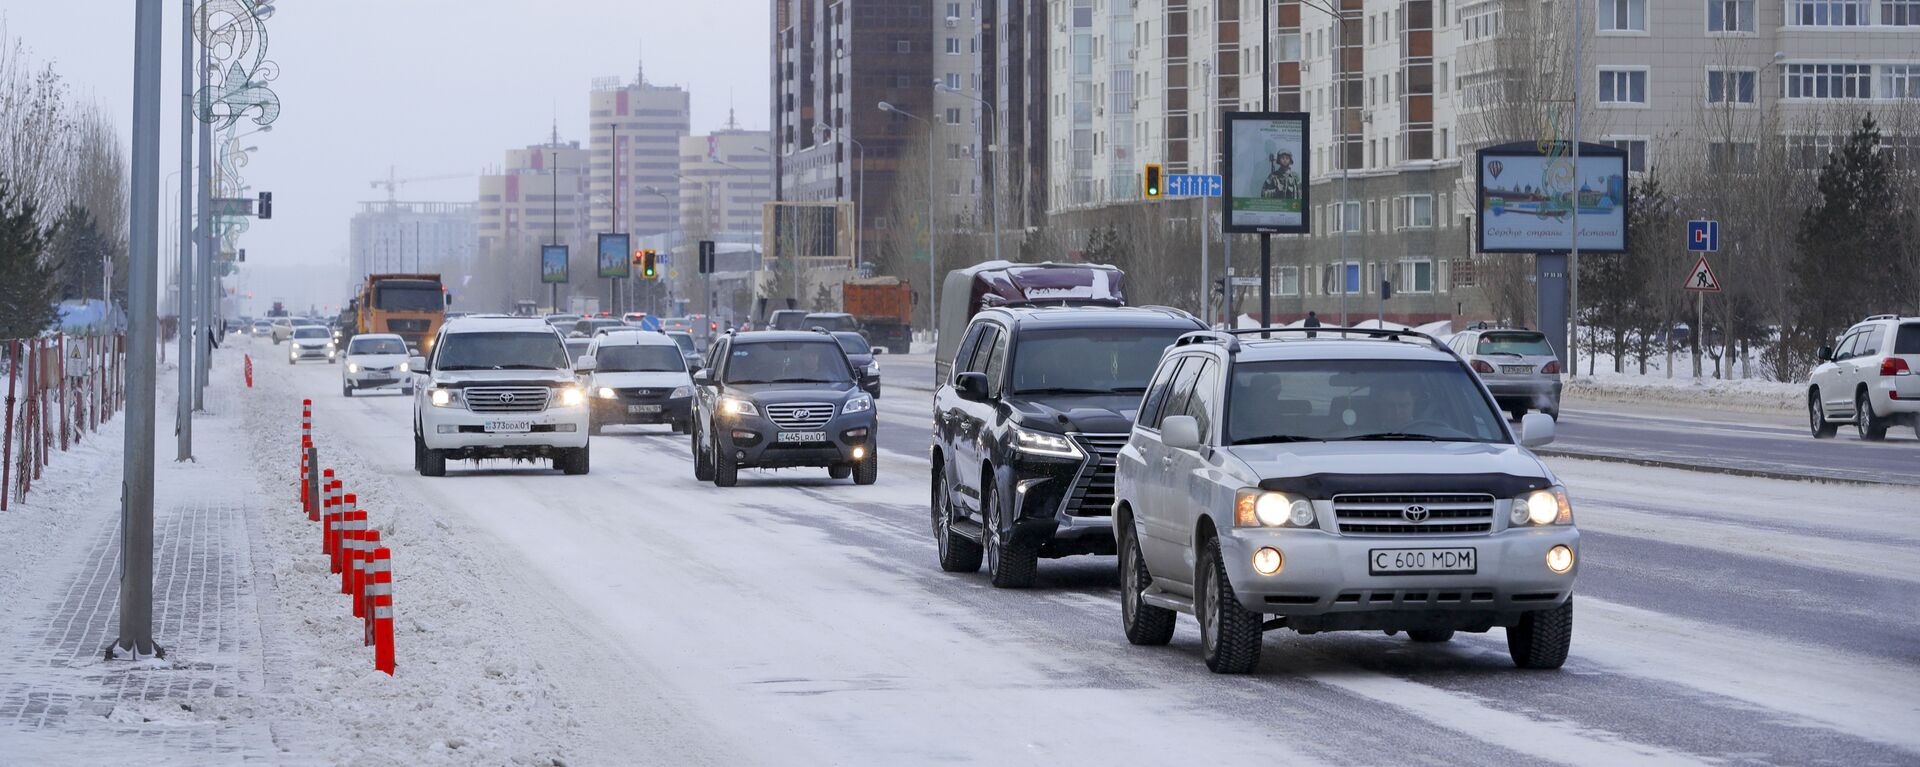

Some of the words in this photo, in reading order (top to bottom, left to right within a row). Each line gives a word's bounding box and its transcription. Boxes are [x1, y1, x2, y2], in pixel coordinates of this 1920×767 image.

[1487, 227, 1522, 238] Сердце
[1376, 552, 1388, 569] C
[1395, 552, 1425, 568] 600
[1432, 551, 1471, 568] MDM
